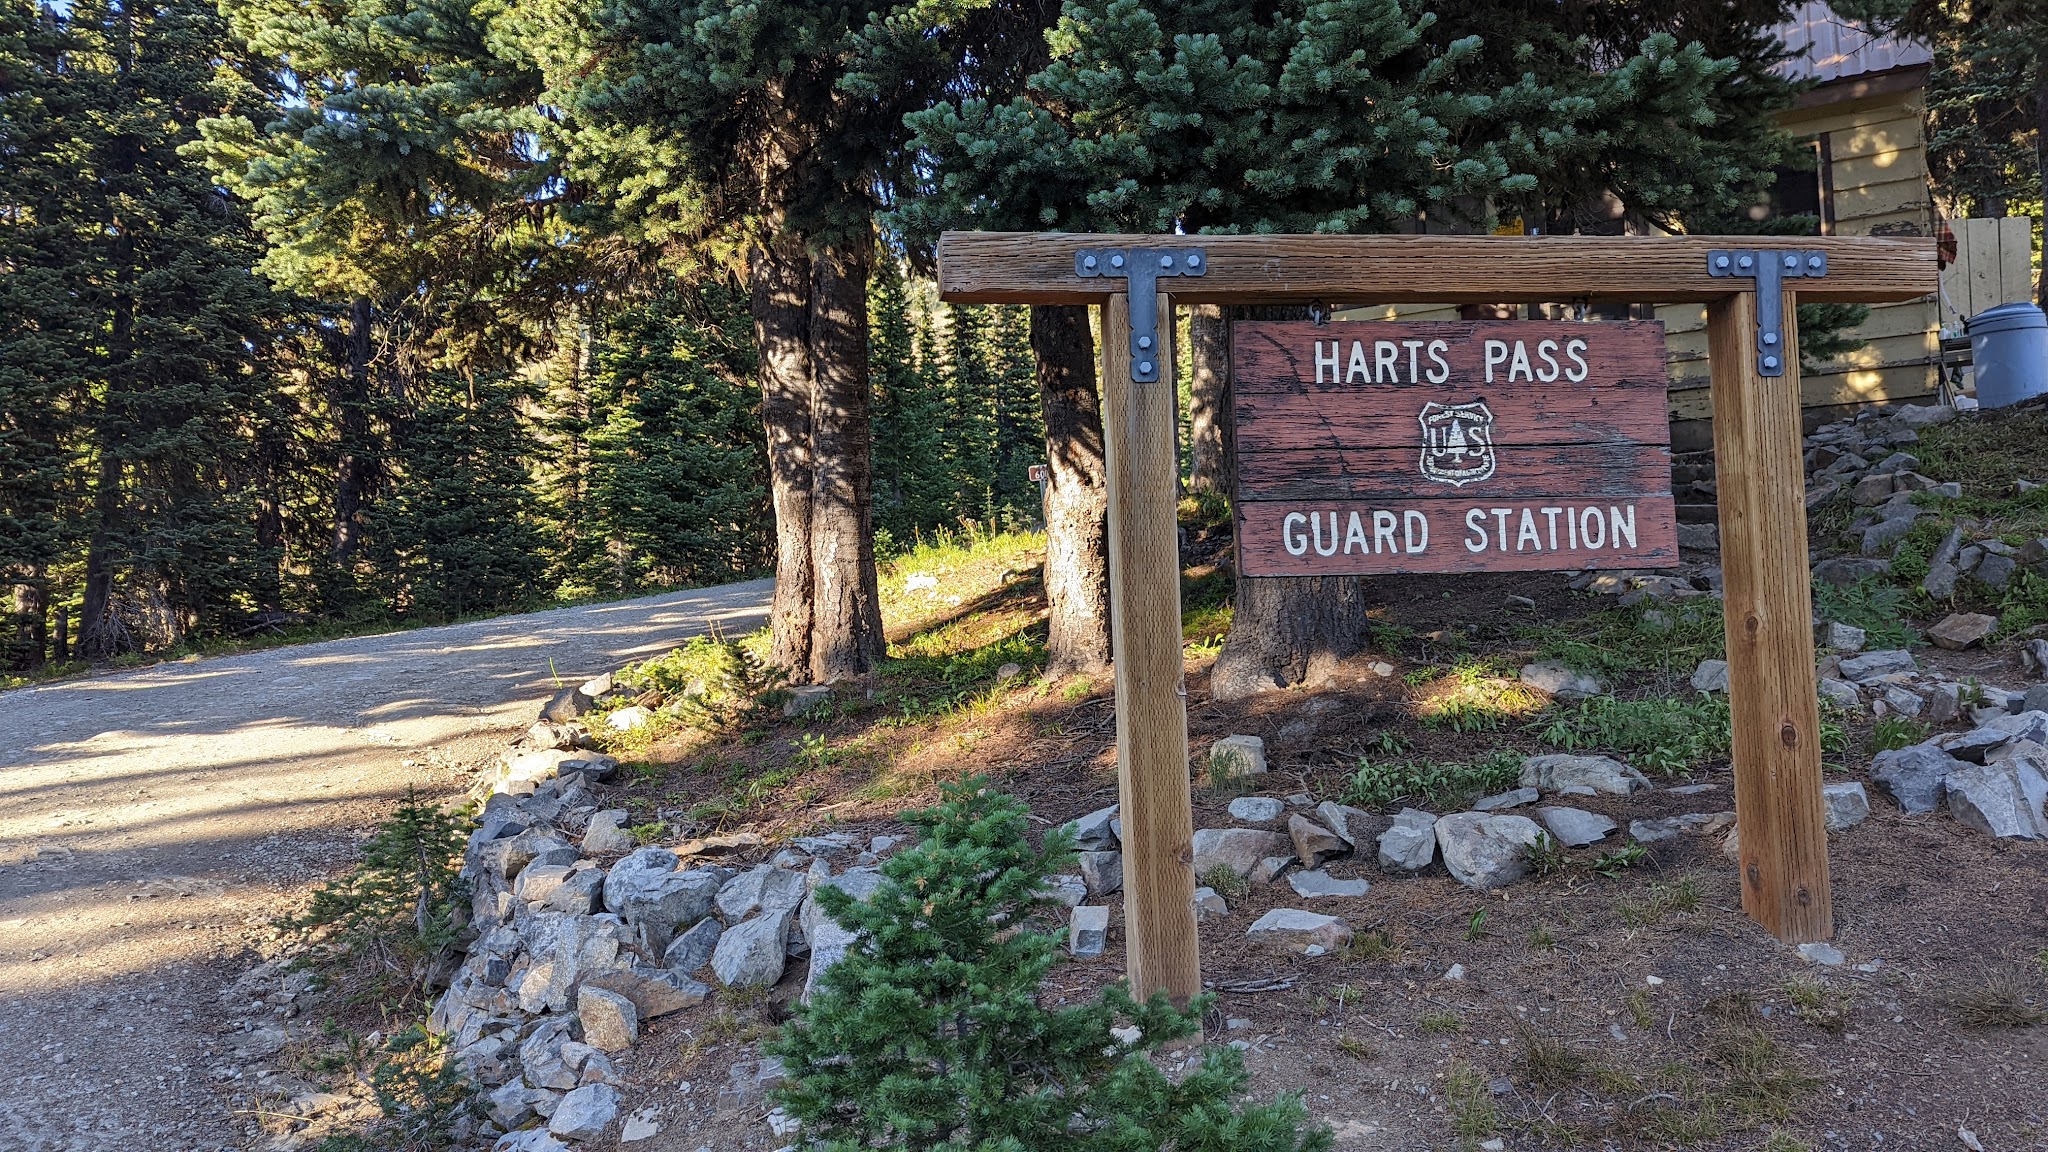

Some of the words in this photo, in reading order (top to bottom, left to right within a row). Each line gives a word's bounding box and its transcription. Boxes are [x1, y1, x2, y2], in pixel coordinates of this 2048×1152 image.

[1314, 339, 1450, 384] HARTS
[1484, 339, 1589, 383] PASS
[1283, 508, 1428, 557] GUARD
[1464, 504, 1637, 552] STATION
